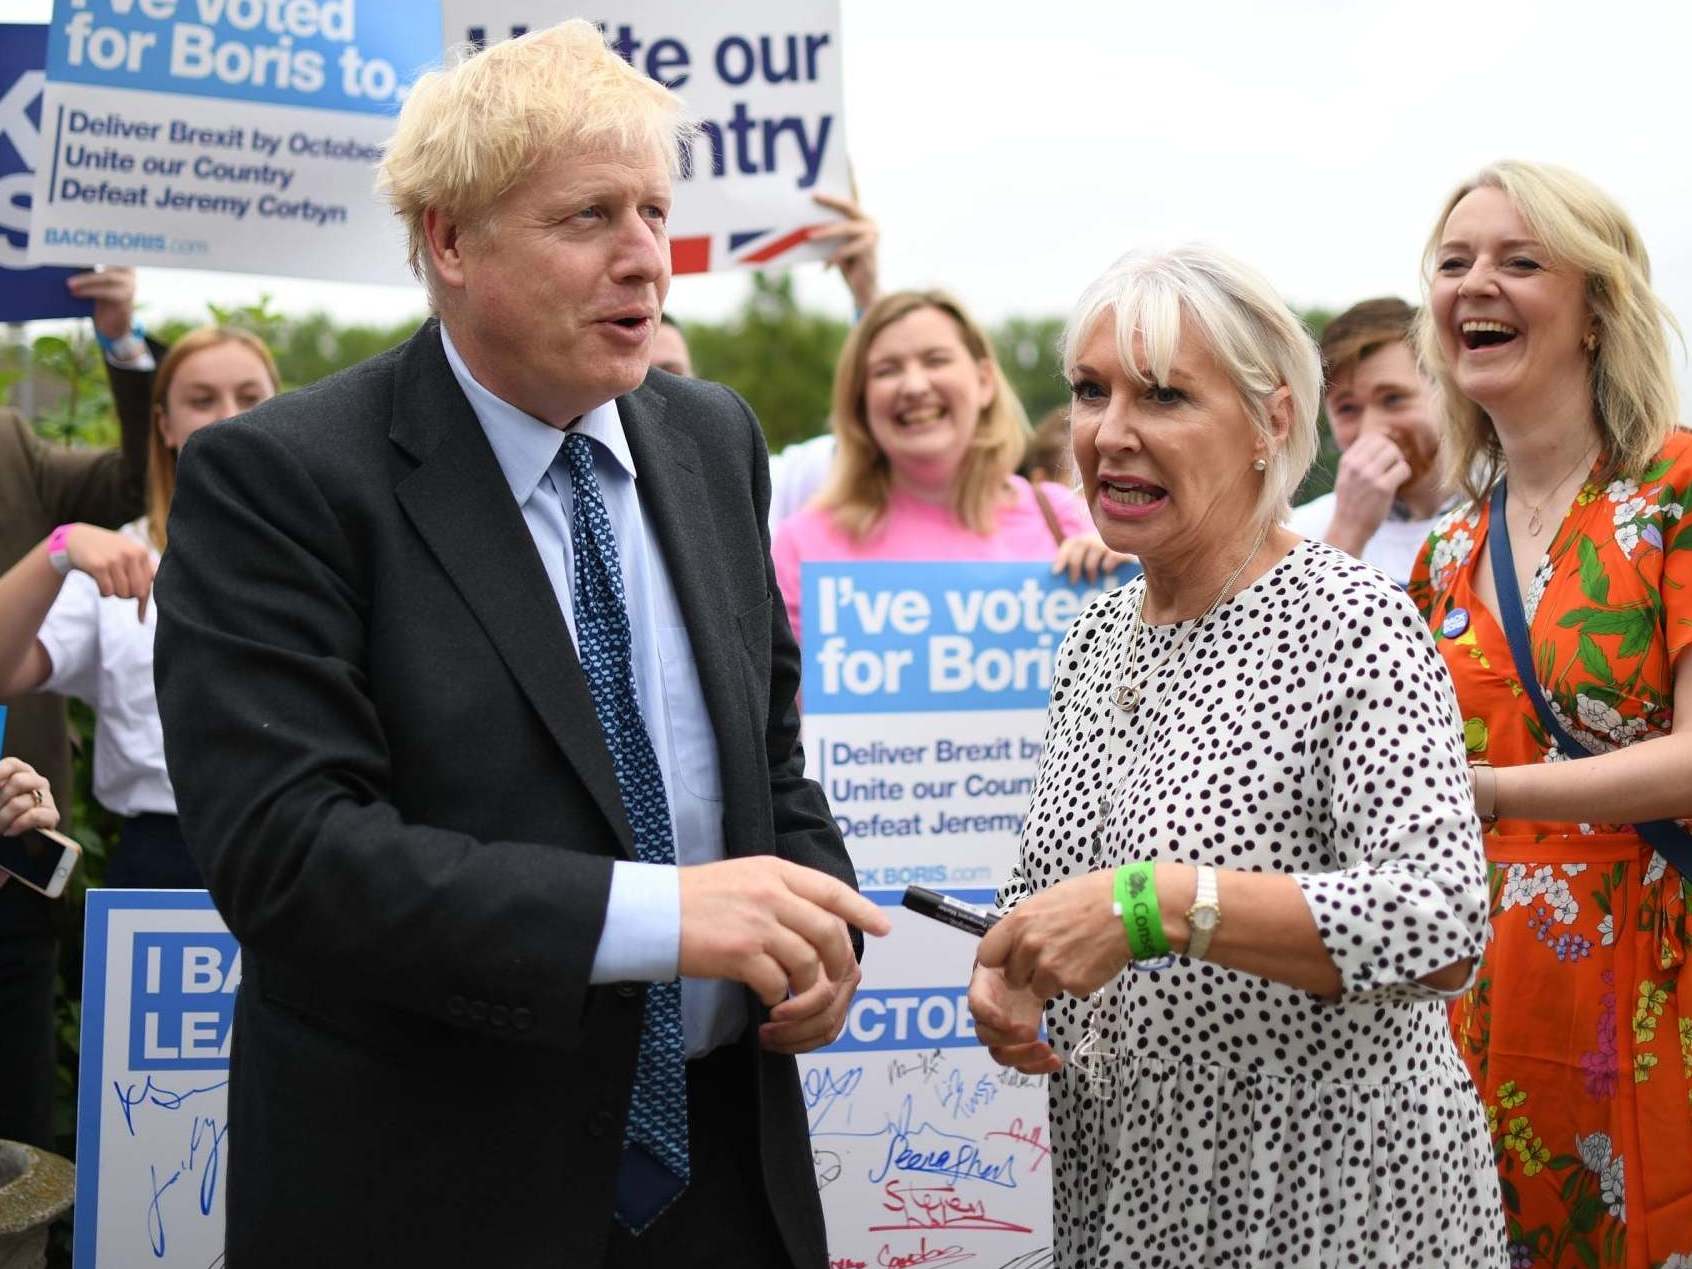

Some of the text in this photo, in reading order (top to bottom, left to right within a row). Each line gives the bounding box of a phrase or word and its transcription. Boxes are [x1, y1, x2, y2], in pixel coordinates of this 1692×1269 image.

[65, 10, 157, 73] for
[169, 21, 326, 93] Boris
[715, 34, 831, 87] our
[68, 109, 163, 141] Deliver
[168, 119, 245, 149] Brexit
[252, 127, 282, 157] by
[677, 103, 833, 190] ntry
[65, 144, 295, 190] Unite our Country
[60, 178, 347, 227] Defeat Jeremy Corbyn
[945, 576, 1119, 633] vote
[816, 634, 1055, 695] for Bori
[832, 741, 928, 766] Deliver
[936, 738, 1011, 762] Brexit
[832, 774, 1034, 802] Unite our Coun
[931, 811, 1026, 837] Jeremy
[146, 946, 162, 994] I
